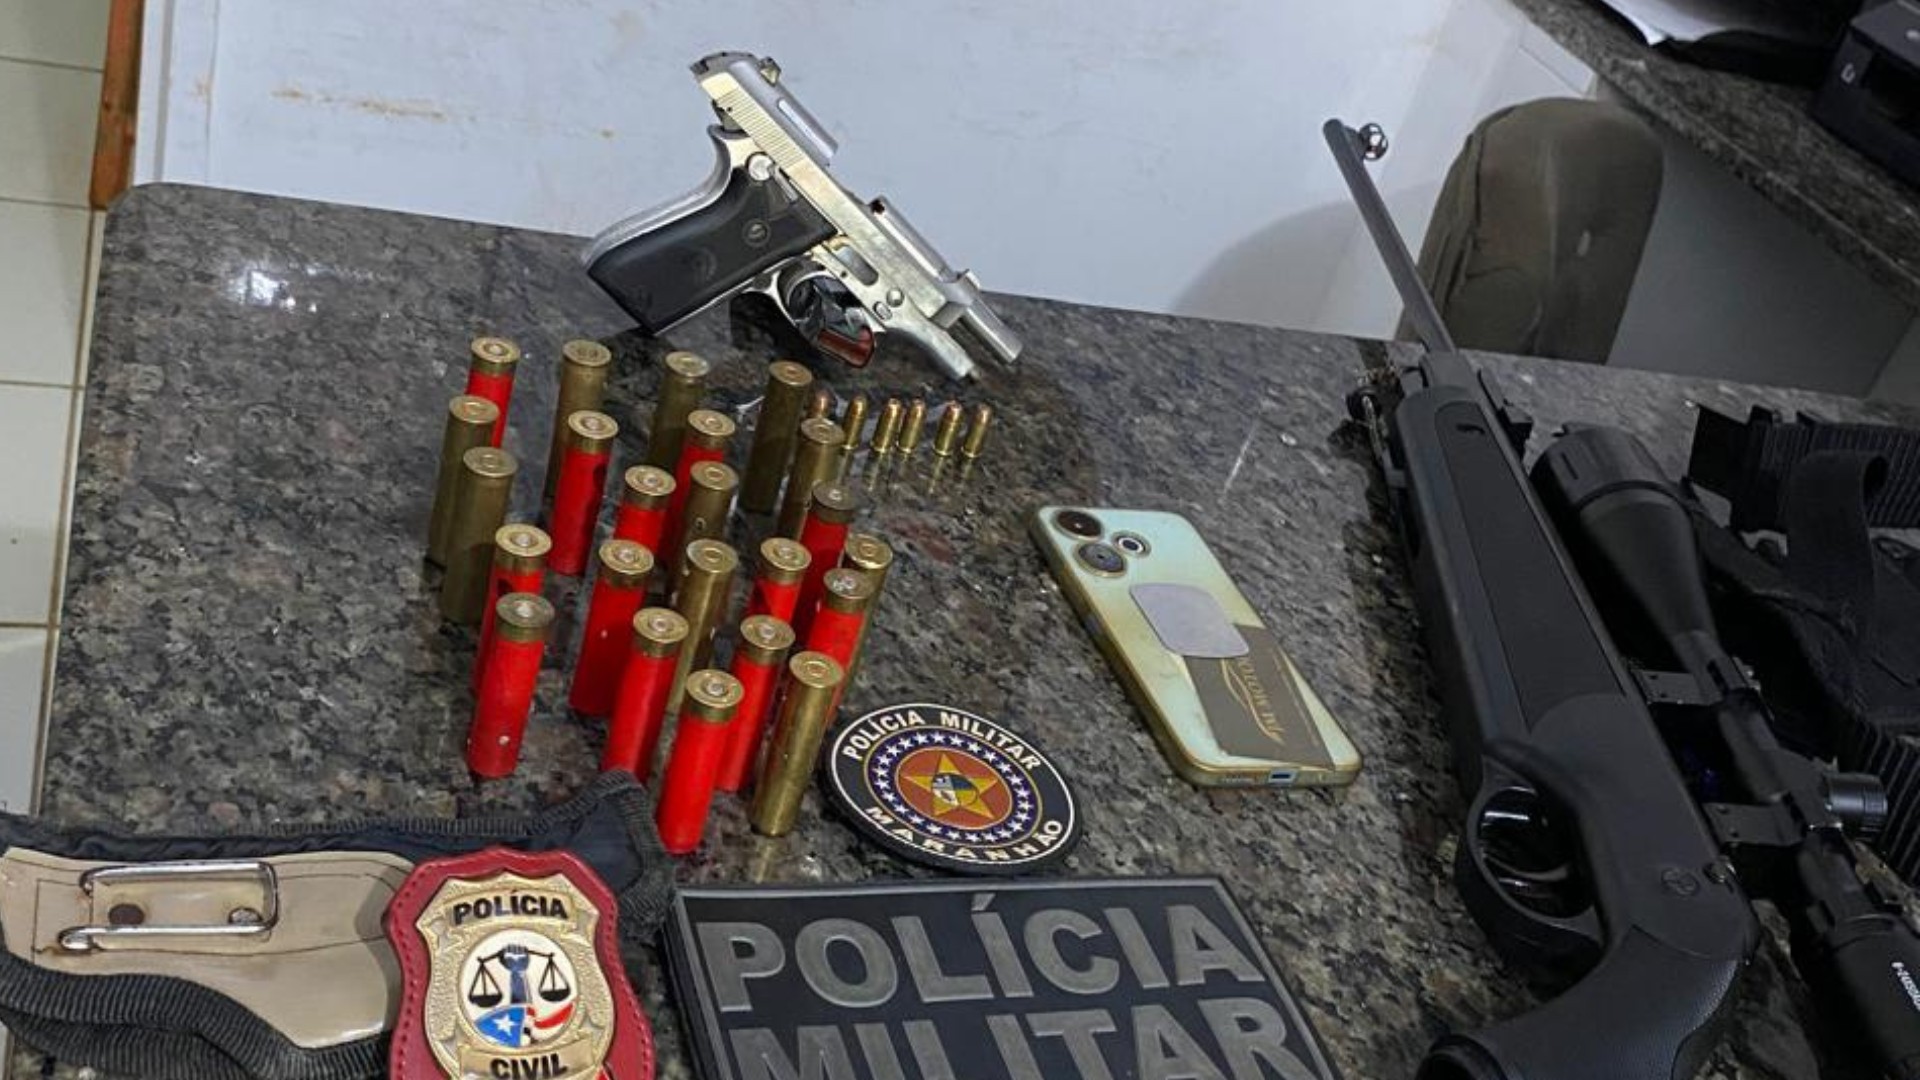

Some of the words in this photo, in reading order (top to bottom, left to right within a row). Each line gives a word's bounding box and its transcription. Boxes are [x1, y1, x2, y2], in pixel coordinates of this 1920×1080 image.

[843, 709, 925, 761] POLÍCIA
[939, 711, 1042, 771] MILITAR
[863, 806, 1063, 861] MARANHÃO
[453, 889, 569, 925] POLÍCIA
[696, 893, 1265, 1012] POLÍCIA
[490, 1052, 569, 1080] CIVIL
